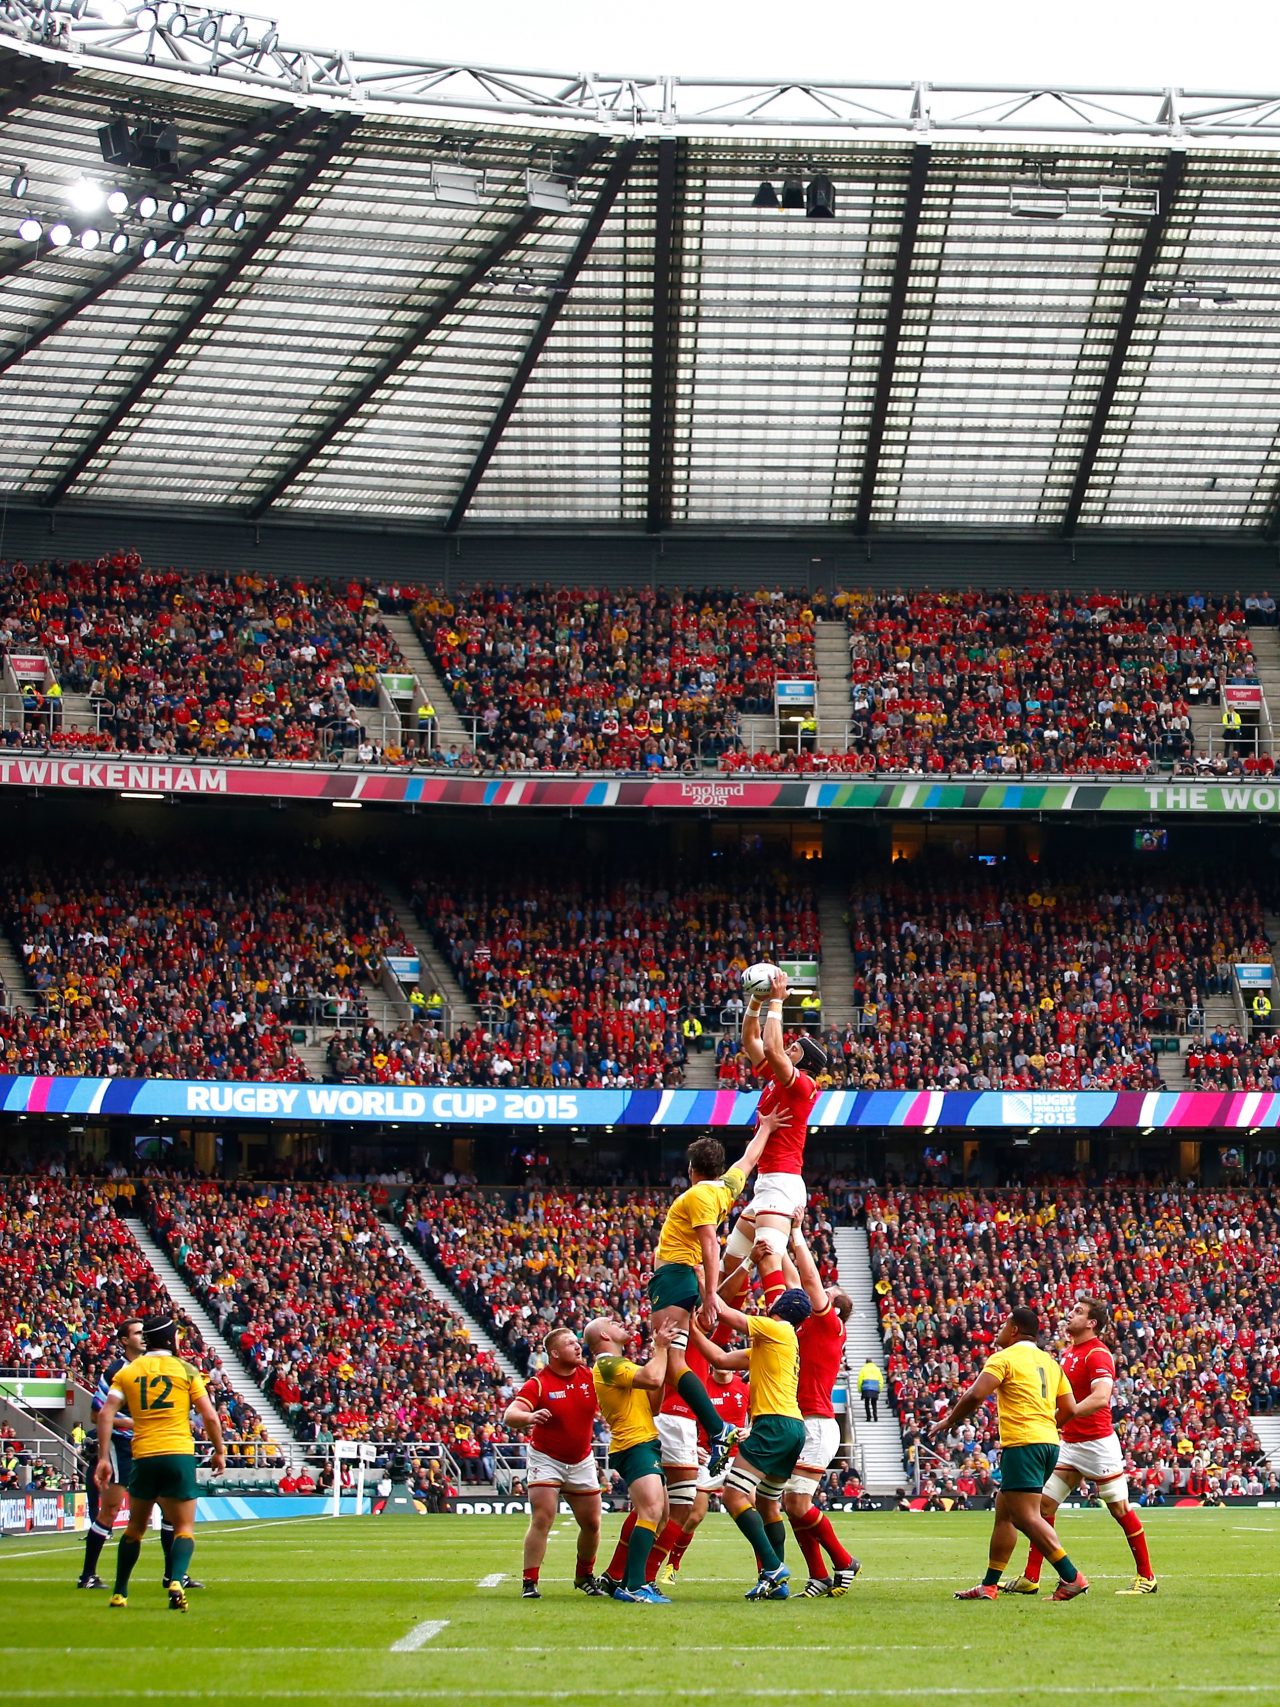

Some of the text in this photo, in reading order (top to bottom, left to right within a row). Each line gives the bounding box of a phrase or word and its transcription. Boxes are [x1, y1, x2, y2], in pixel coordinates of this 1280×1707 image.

[0, 760, 228, 793] TWICKENHAM
[681, 783, 745, 799] England
[1144, 787, 1208, 810] THE
[186, 1086, 578, 1120] RUGBY WORLD CUP 2015
[1033, 1094, 1077, 1105] RUGBY
[1033, 1112, 1077, 1124] 2015
[133, 1374, 175, 1411] 12
[1038, 1367, 1047, 1399] 1
